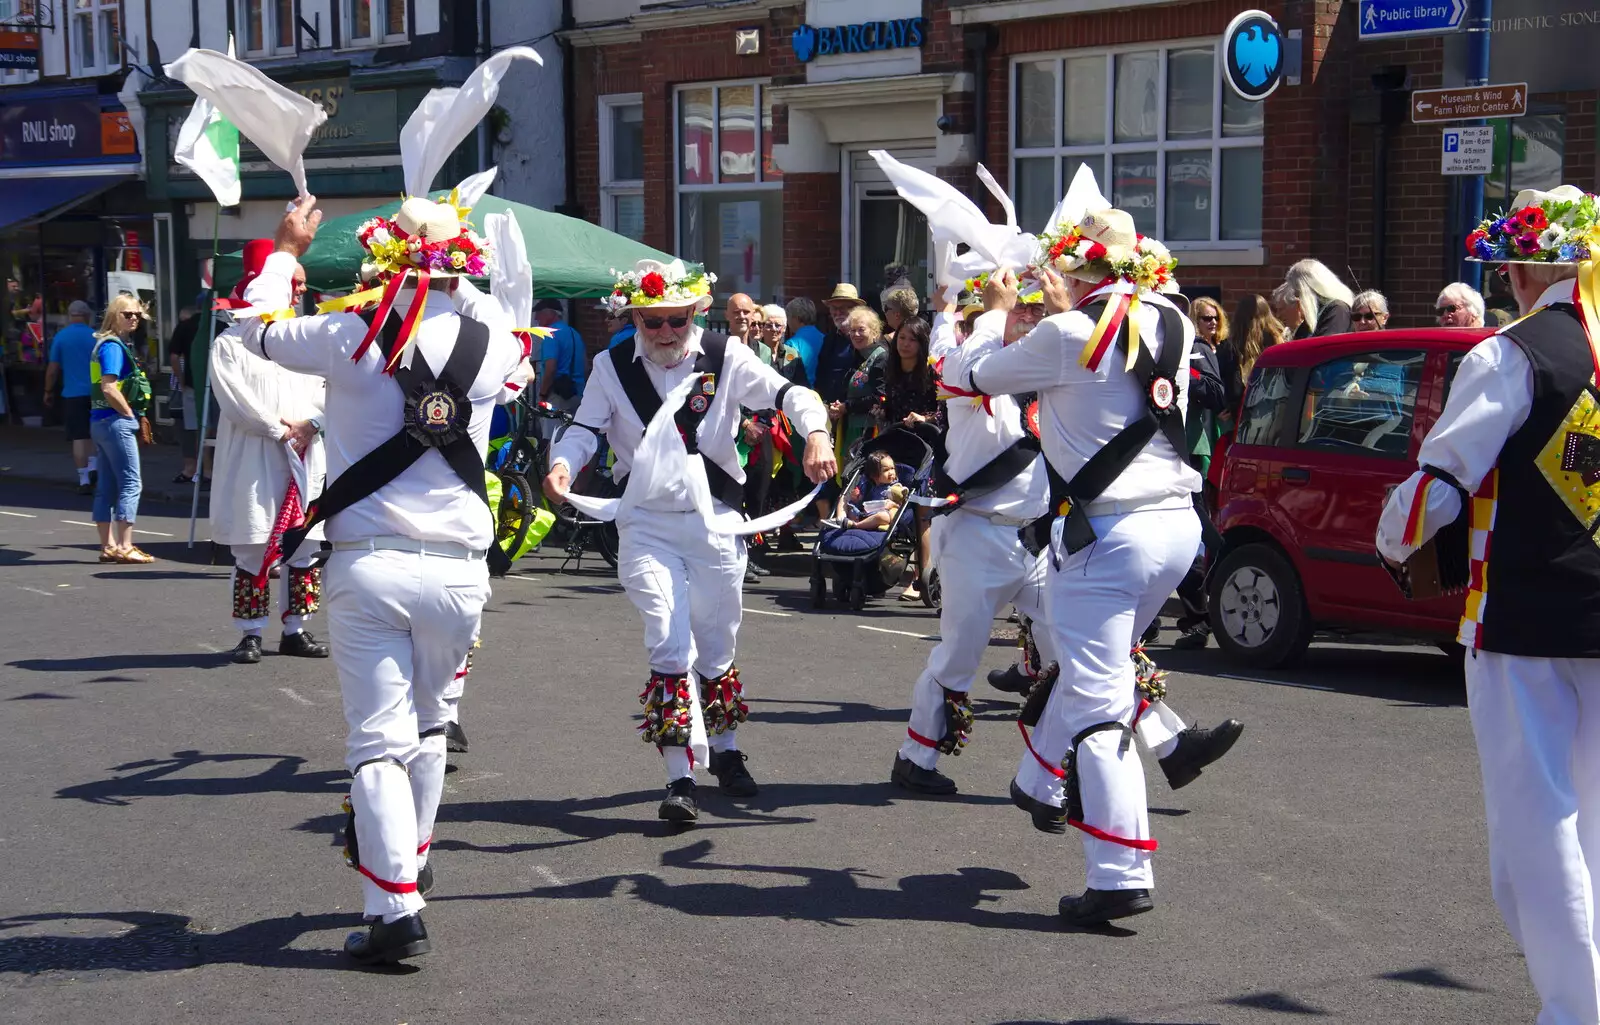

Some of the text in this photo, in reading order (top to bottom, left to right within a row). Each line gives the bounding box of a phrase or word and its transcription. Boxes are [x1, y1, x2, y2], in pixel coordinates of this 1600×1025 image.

[1380, 6, 1448, 22] Public library
[818, 17, 923, 55] BARCLAYS
[15, 53, 37, 65] shop
[1441, 91, 1502, 103] Museum & Wind
[1434, 102, 1509, 115] Farm Visitor Centre
[22, 118, 76, 148] RNLI shop
[1447, 135, 1458, 151] P
